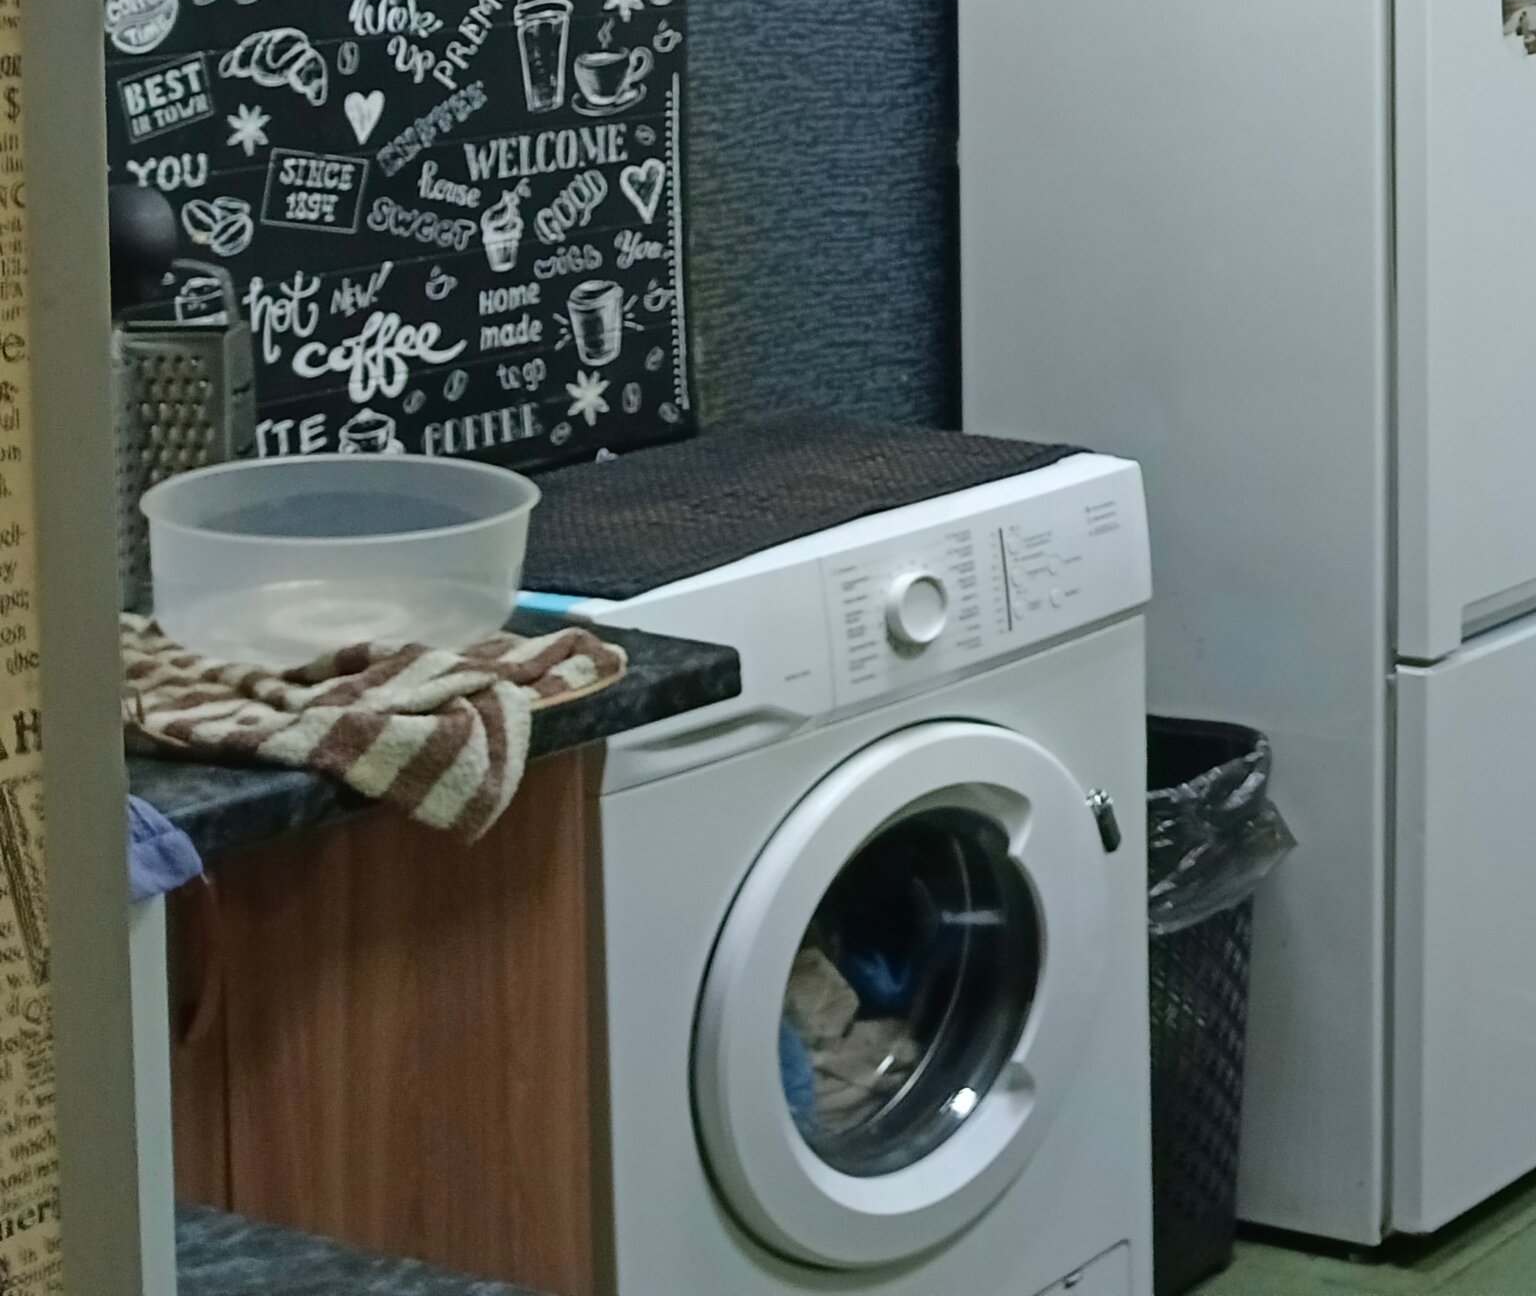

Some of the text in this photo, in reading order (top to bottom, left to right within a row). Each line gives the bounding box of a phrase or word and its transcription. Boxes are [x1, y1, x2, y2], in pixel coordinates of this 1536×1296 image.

[123, 61, 203, 116] BEST
[131, 93, 210, 136] IN TOWN
[126, 153, 207, 191] YOU
[279, 158, 355, 191] SINCE
[463, 123, 628, 181] WELCOME
[418, 160, 481, 207] house
[330, 261, 394, 317] NEW!
[242, 270, 321, 364] hot
[480, 313, 543, 351] made
[292, 311, 467, 403] coffee
[256, 413, 328, 457] TTE
[422, 403, 544, 455] COFFEE
